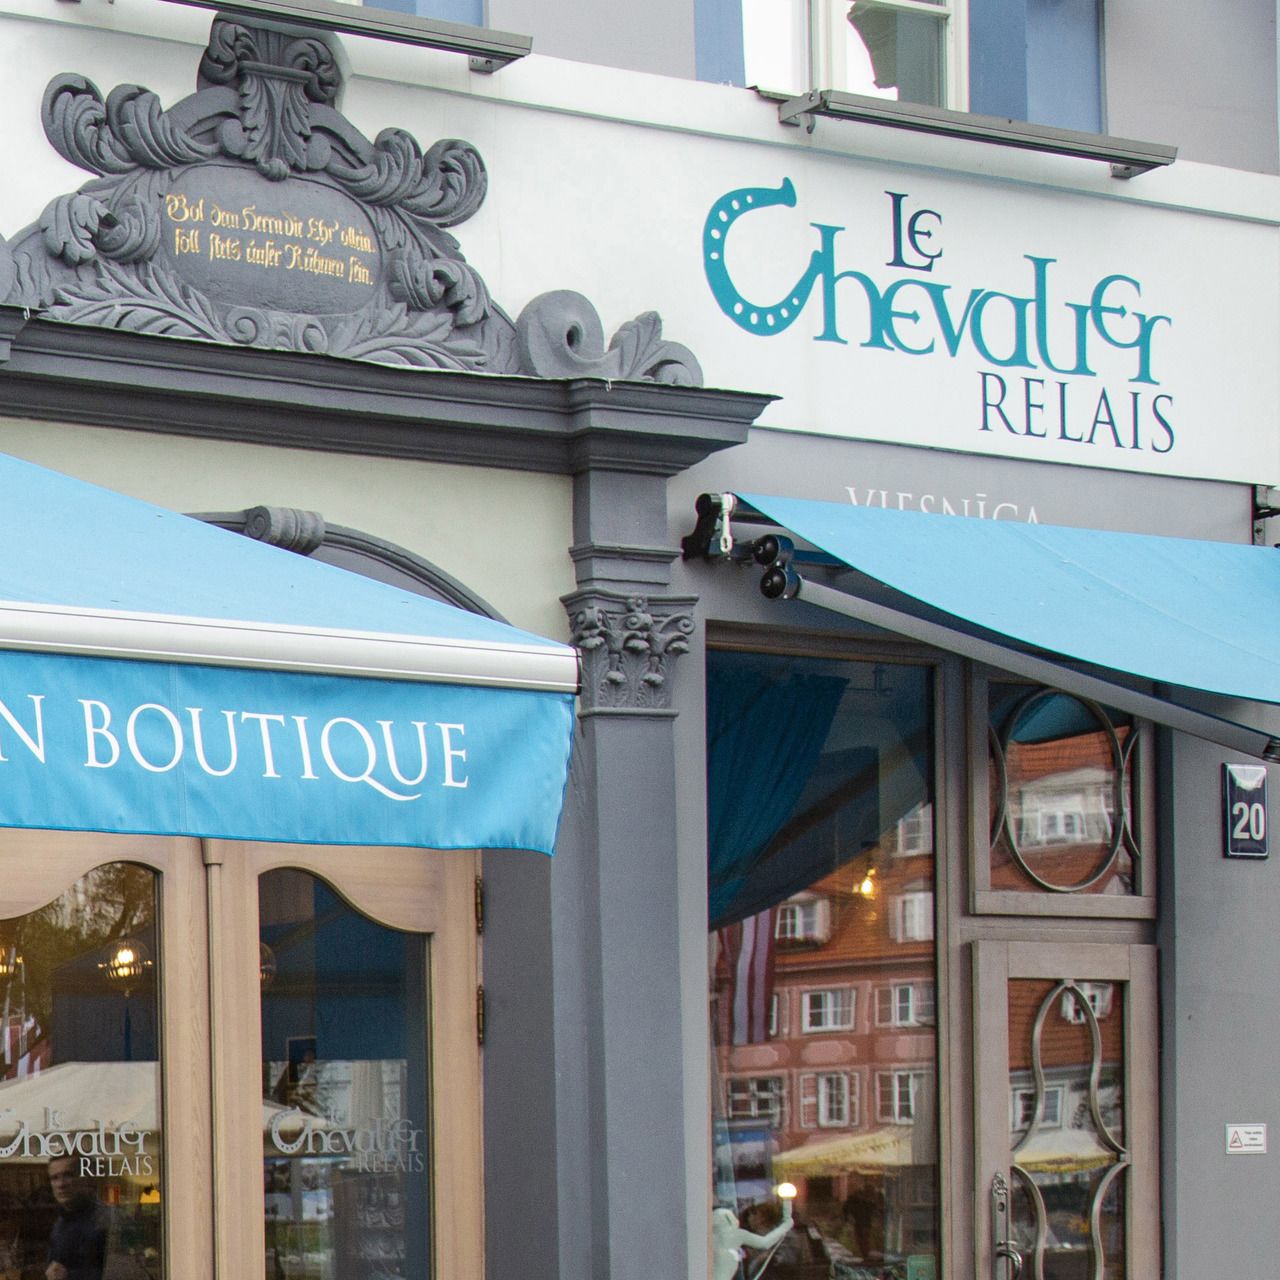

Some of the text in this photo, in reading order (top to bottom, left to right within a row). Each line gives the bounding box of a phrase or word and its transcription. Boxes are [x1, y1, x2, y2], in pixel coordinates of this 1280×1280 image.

[978, 371, 1175, 453] RELAIS
[78, 699, 470, 801] BOUTIQUE
[1232, 801, 1265, 841] 20
[80, 1156, 153, 1177] RELAIS
[358, 1152, 425, 1174] RELAIS
